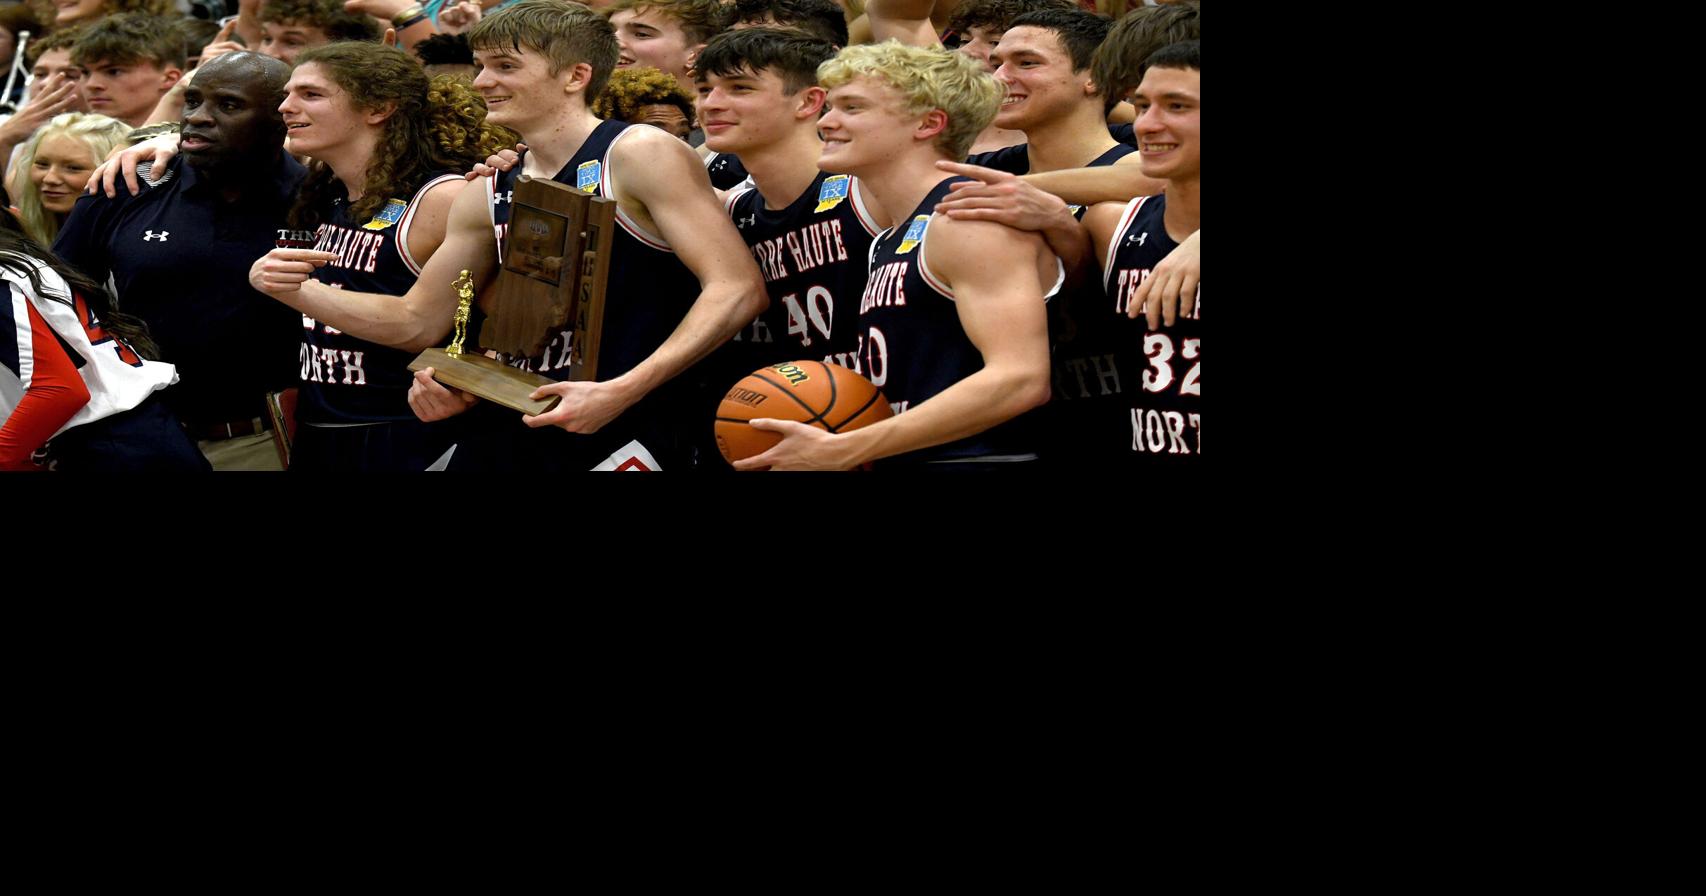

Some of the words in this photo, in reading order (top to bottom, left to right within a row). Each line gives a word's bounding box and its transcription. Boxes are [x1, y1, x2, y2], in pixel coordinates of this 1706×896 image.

[786, 218, 848, 272] HAUTE
[782, 285, 834, 347] 40
[1142, 333, 1201, 396] 32
